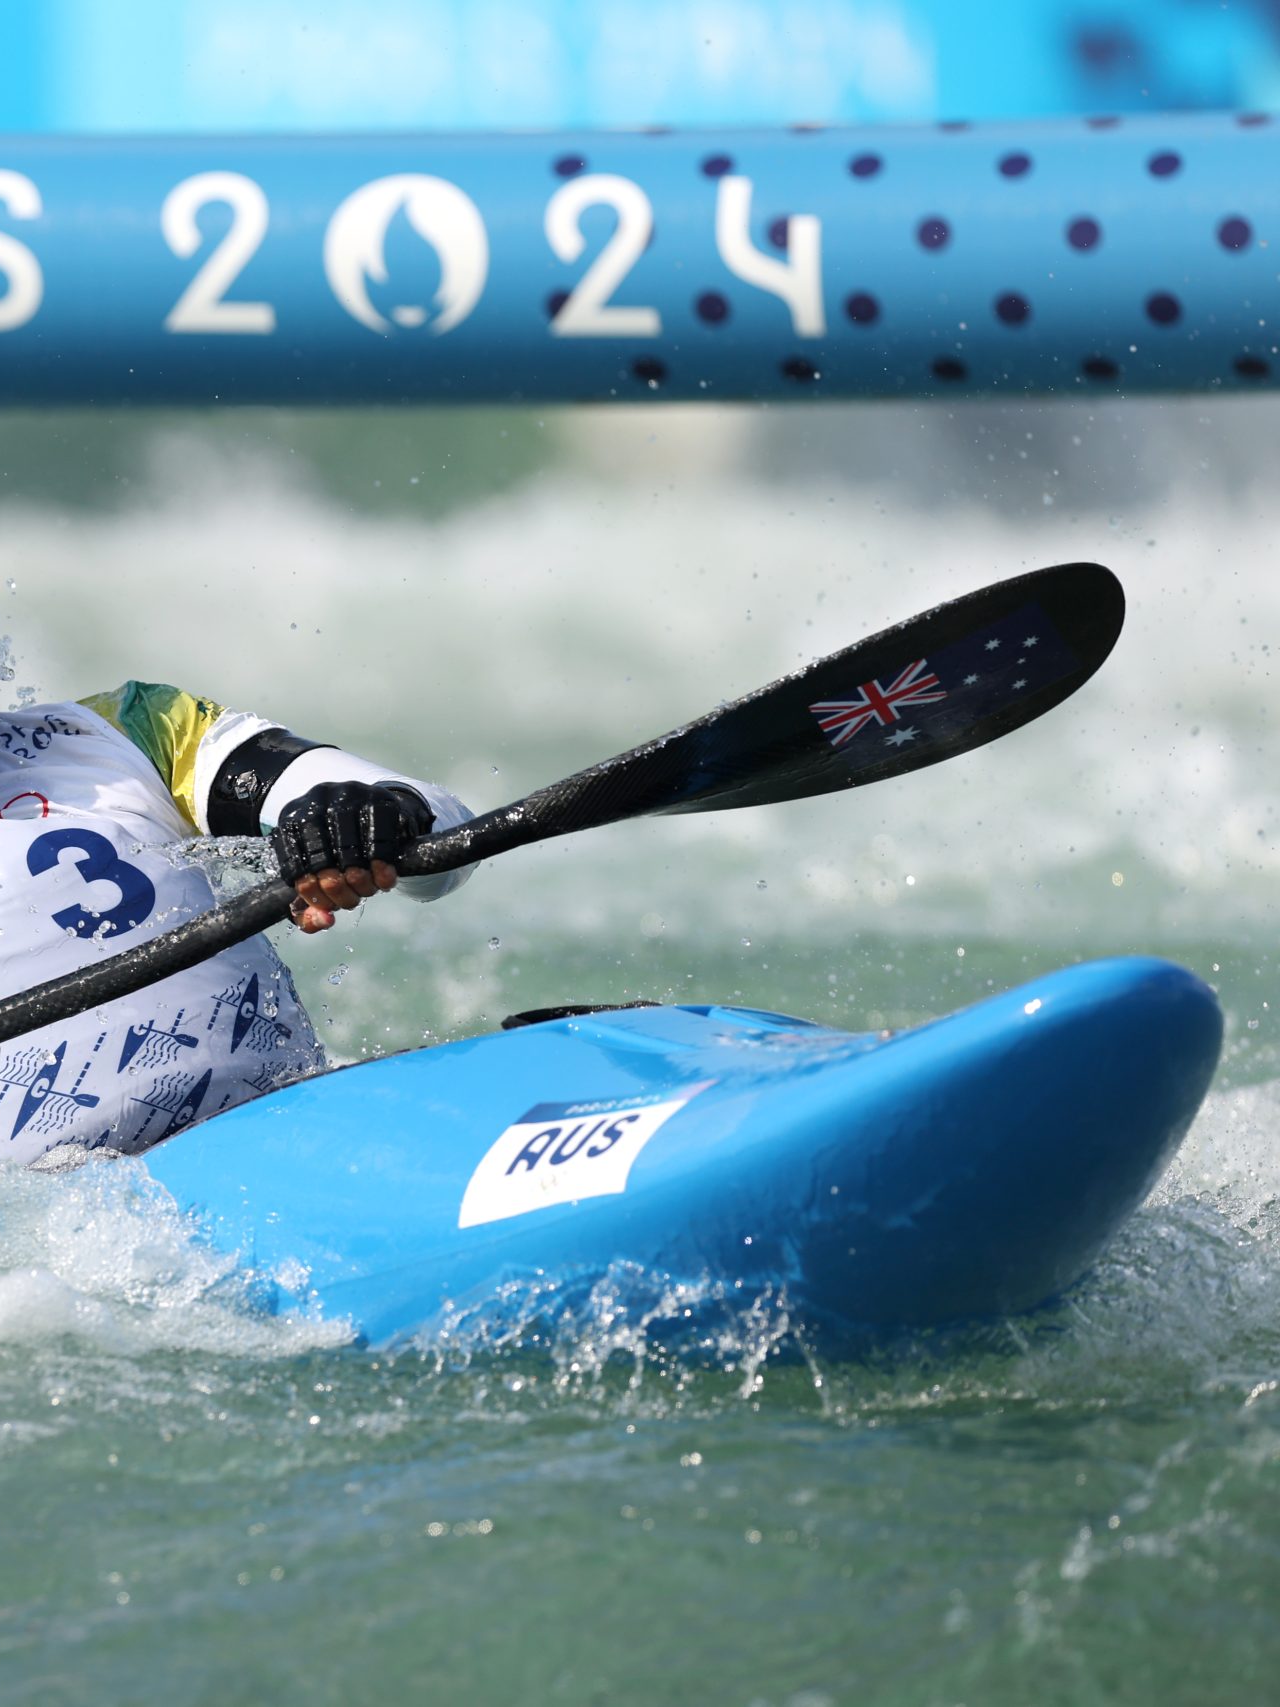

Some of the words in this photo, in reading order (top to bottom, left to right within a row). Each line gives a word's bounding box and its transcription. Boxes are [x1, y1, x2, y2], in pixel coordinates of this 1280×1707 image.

[160, 170, 827, 338] 2024
[26, 827, 156, 939] 3
[505, 1114, 641, 1176] AUS
